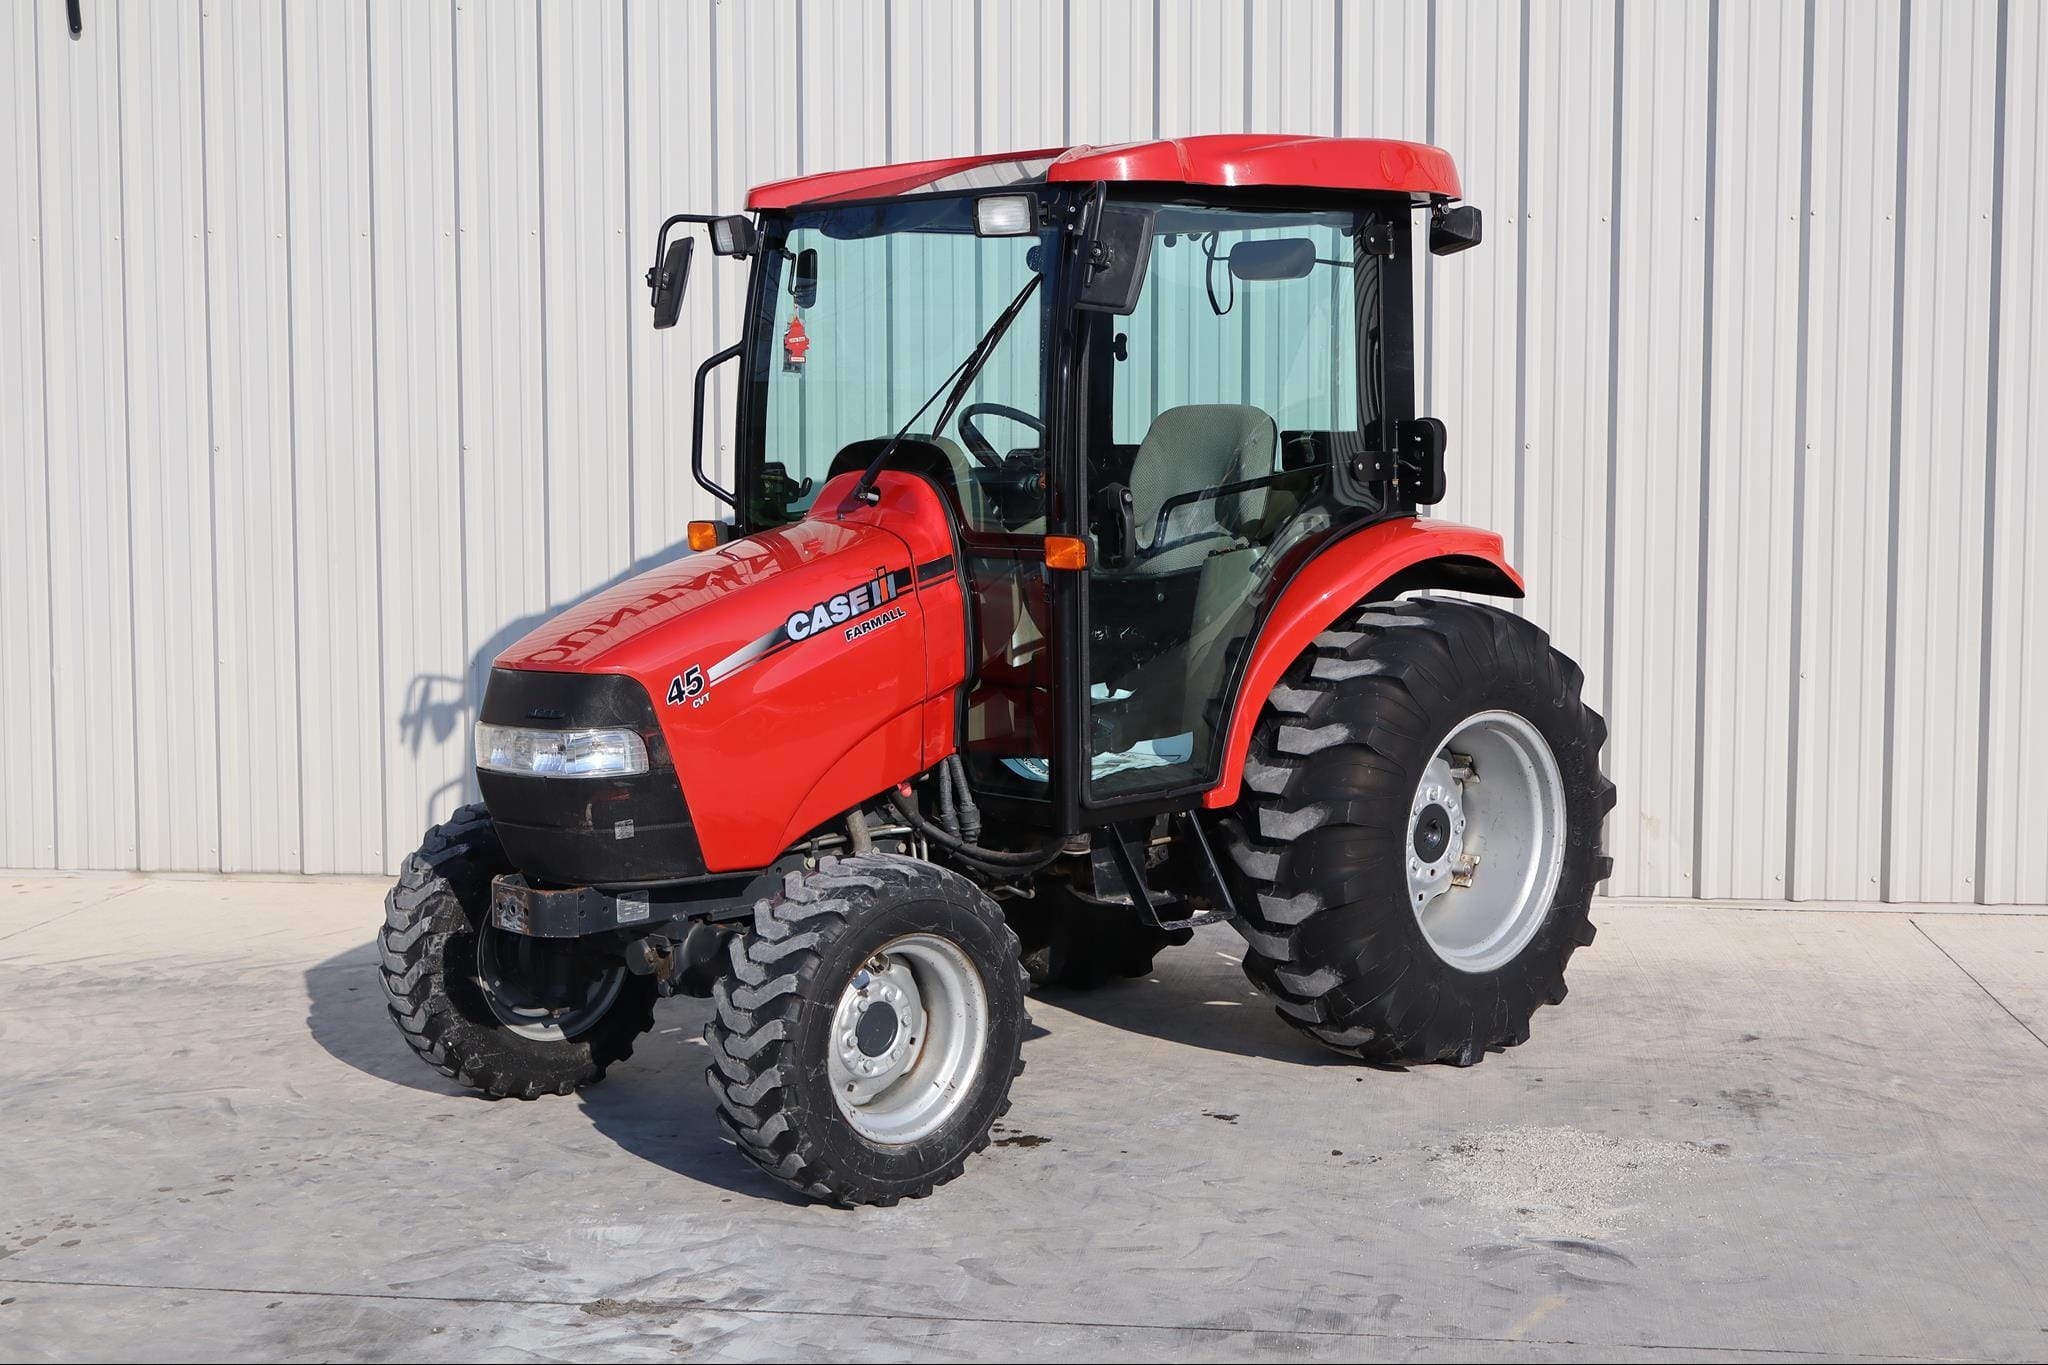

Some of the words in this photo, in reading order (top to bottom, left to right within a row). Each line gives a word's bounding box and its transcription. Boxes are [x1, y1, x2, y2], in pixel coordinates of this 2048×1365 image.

[787, 584, 870, 641] CASE
[844, 606, 906, 642] FARMALL
[666, 664, 705, 705] 45
[692, 692, 710, 708] CVT
